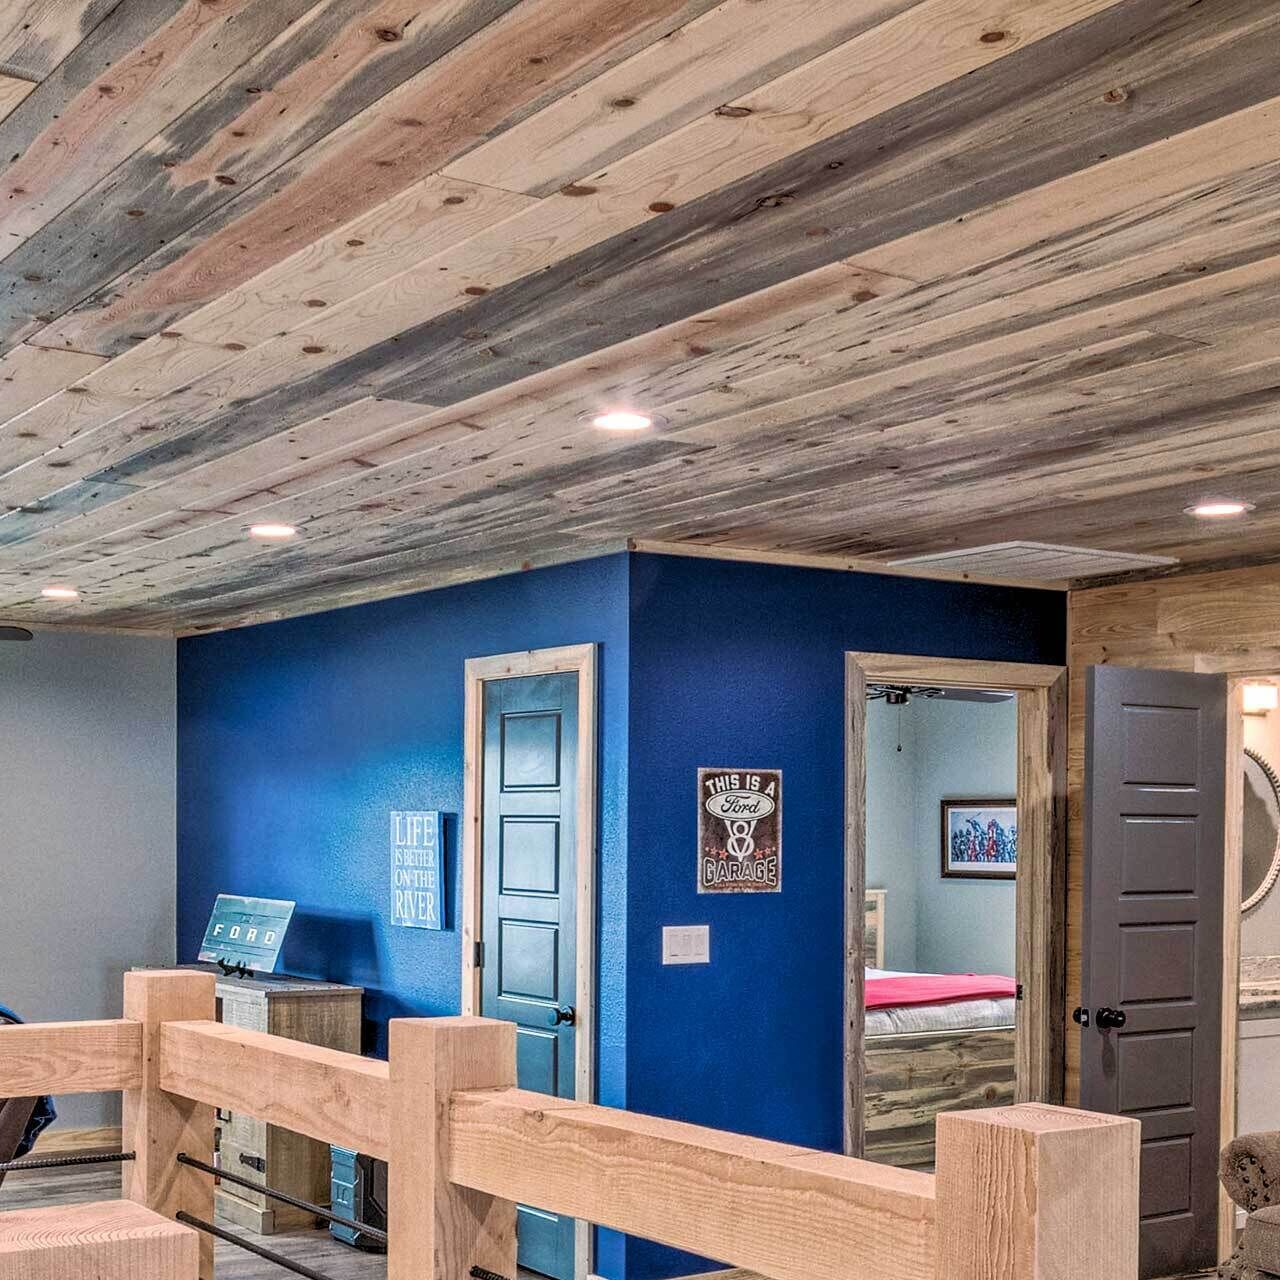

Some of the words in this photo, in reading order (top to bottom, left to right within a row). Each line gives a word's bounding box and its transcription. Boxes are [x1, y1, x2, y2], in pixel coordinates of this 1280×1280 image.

[705, 774, 740, 795] THIS
[746, 775, 761, 791] IS
[765, 782, 776, 797] A
[721, 794, 760, 814] Ford
[395, 816, 434, 846] LIFE
[395, 849, 404, 866] IS
[404, 849, 434, 867] BETTER
[395, 869, 411, 887] ON
[414, 871, 434, 889] THE
[703, 856, 777, 889] GARAGE
[396, 891, 436, 921] RIVER
[213, 924, 276, 945] FORD
